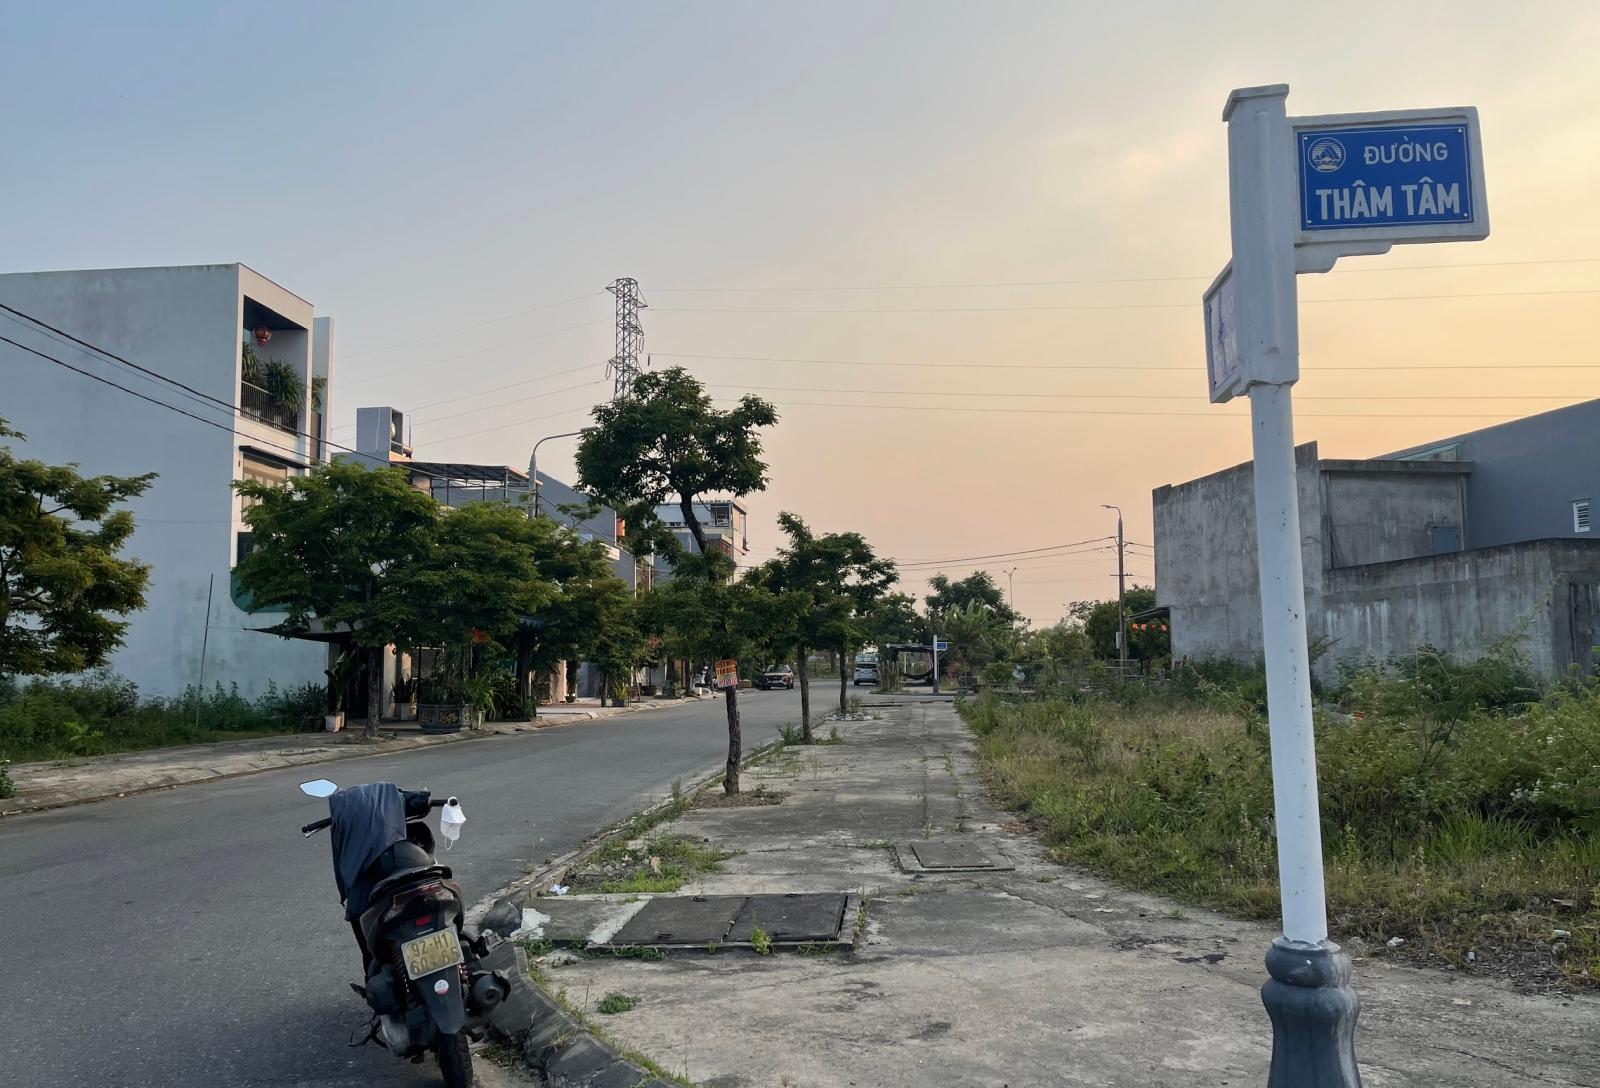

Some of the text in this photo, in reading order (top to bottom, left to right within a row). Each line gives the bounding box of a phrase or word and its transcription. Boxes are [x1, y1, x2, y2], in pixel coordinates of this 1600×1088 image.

[1364, 136, 1448, 165] ĐƯỜNG
[1315, 176, 1460, 220] THÂM TÂM
